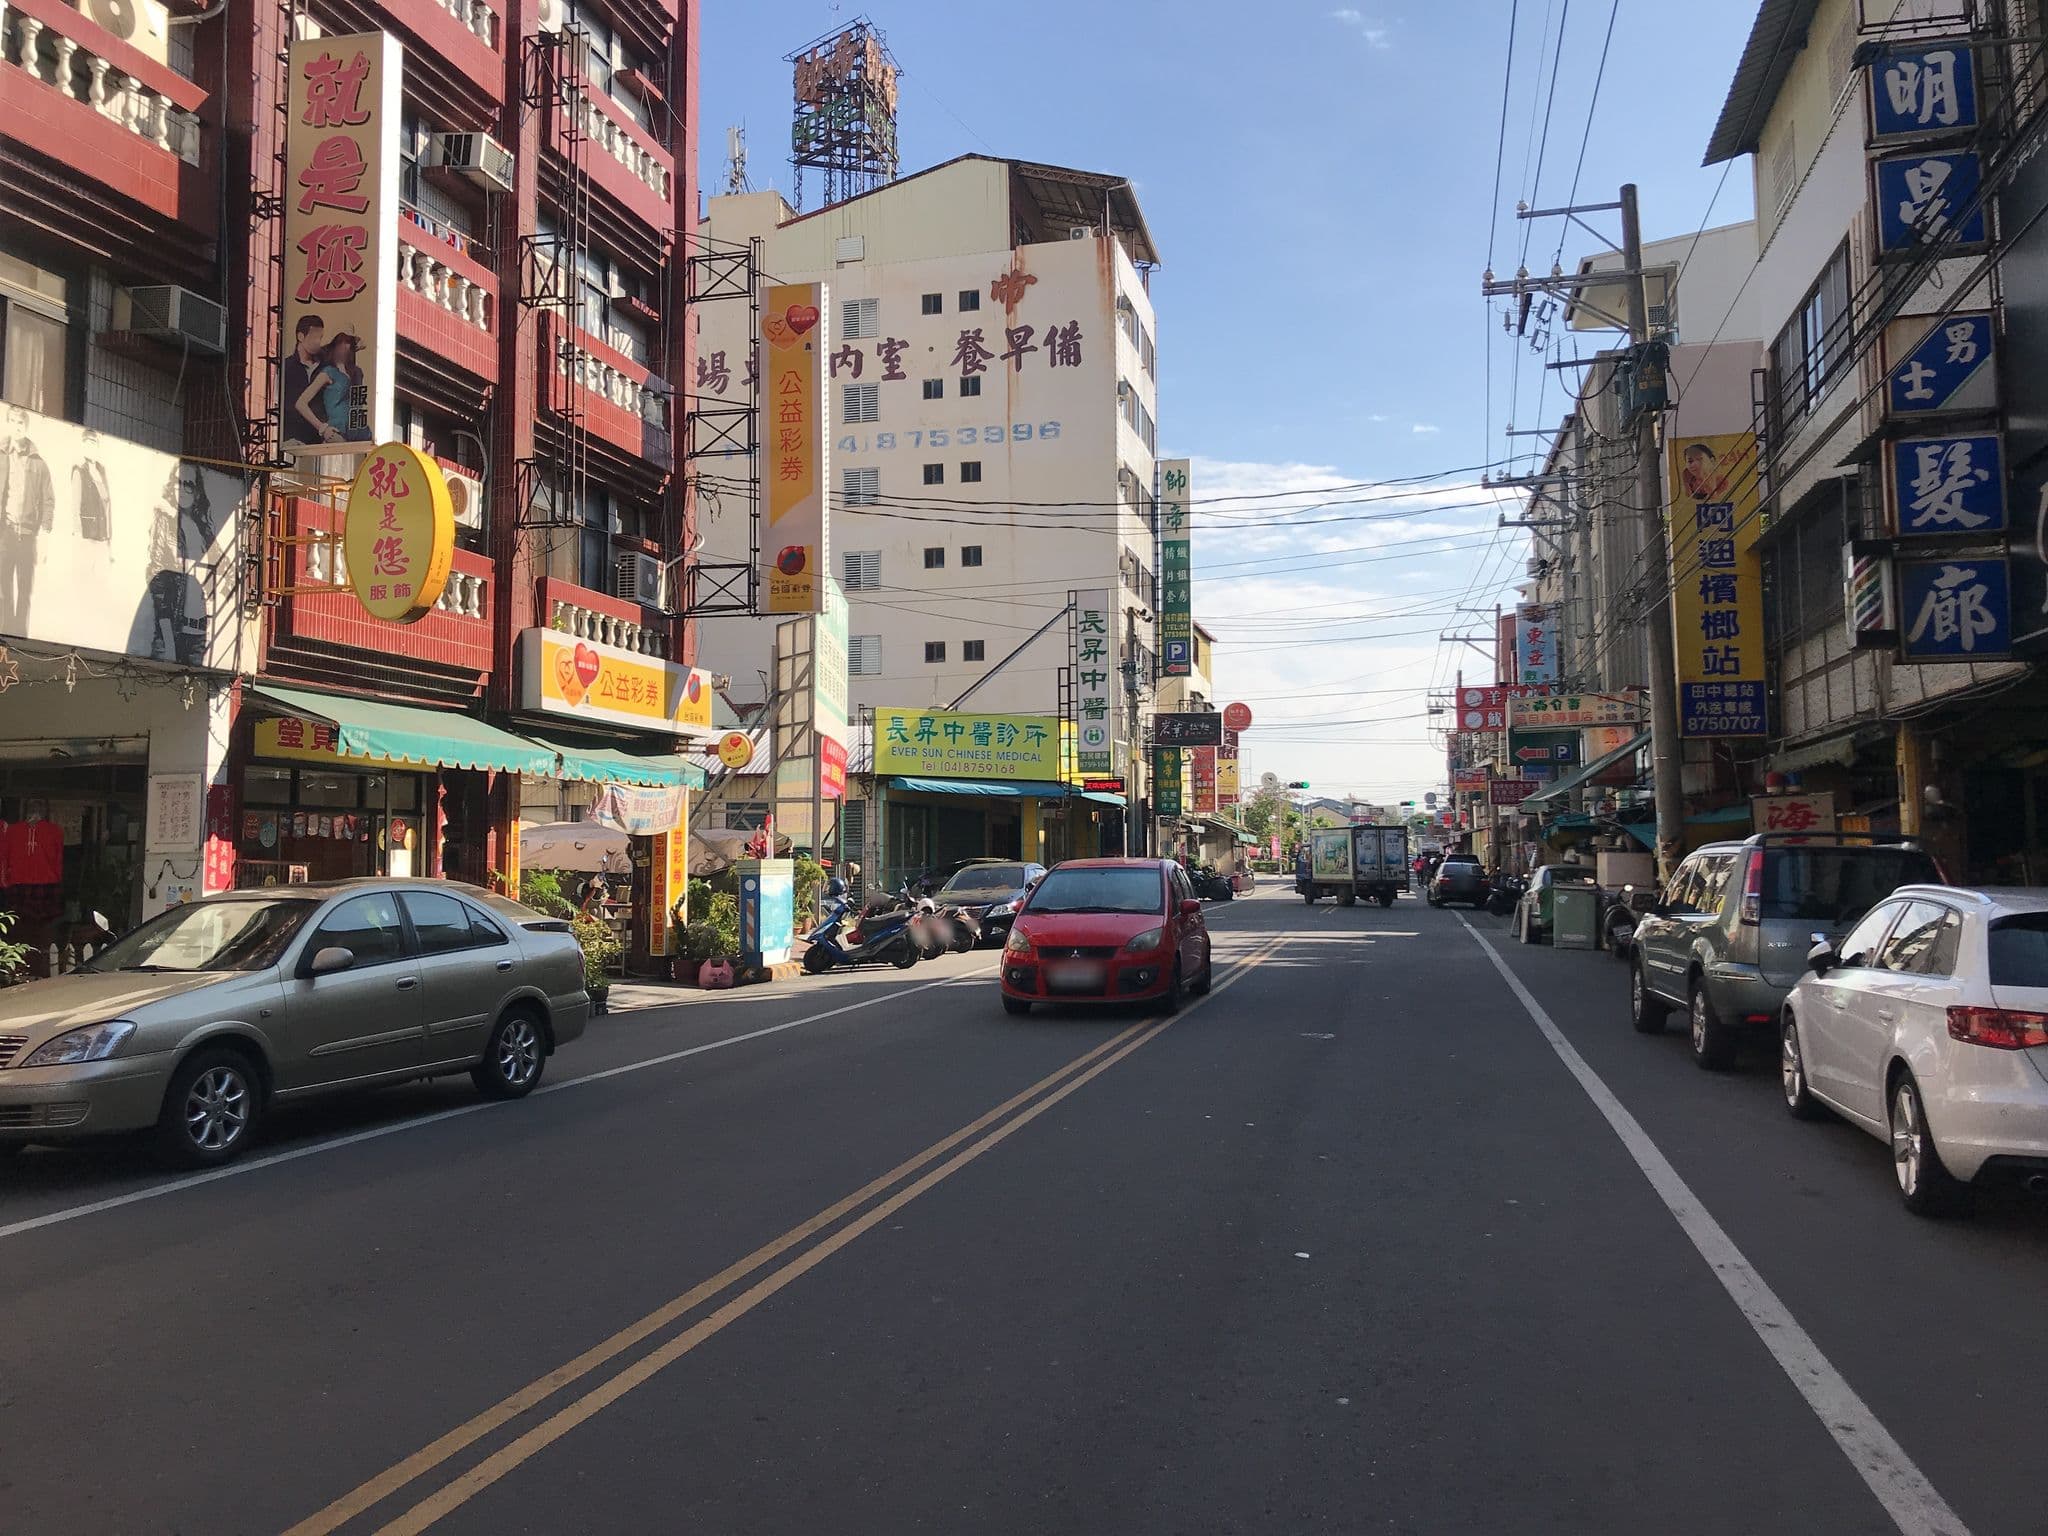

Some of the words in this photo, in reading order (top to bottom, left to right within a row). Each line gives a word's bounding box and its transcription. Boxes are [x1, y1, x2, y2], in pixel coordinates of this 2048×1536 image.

[295, 51, 371, 303] 就是您
[347, 384, 369, 431] 服飾
[779, 370, 804, 481] 公益彩券
[368, 457, 410, 576] 就是您
[1165, 469, 1186, 533] 帥帝
[370, 583, 412, 600] 服飾
[600, 670, 658, 707] 公益彩券
[1079, 610, 1108, 720] 長昇中醫
[886, 715, 1049, 748] 長昇中醫診所
[1687, 716, 1761, 732] 8750707
[891, 746, 918, 757] EVER
[921, 748, 943, 759] SUN
[947, 749, 993, 761] CHINESE
[996, 752, 1043, 763] MEDICAL
[921, 761, 936, 771] Tel
[940, 762, 1016, 774] (04)8759168
[673, 829, 683, 885] 益彩券
